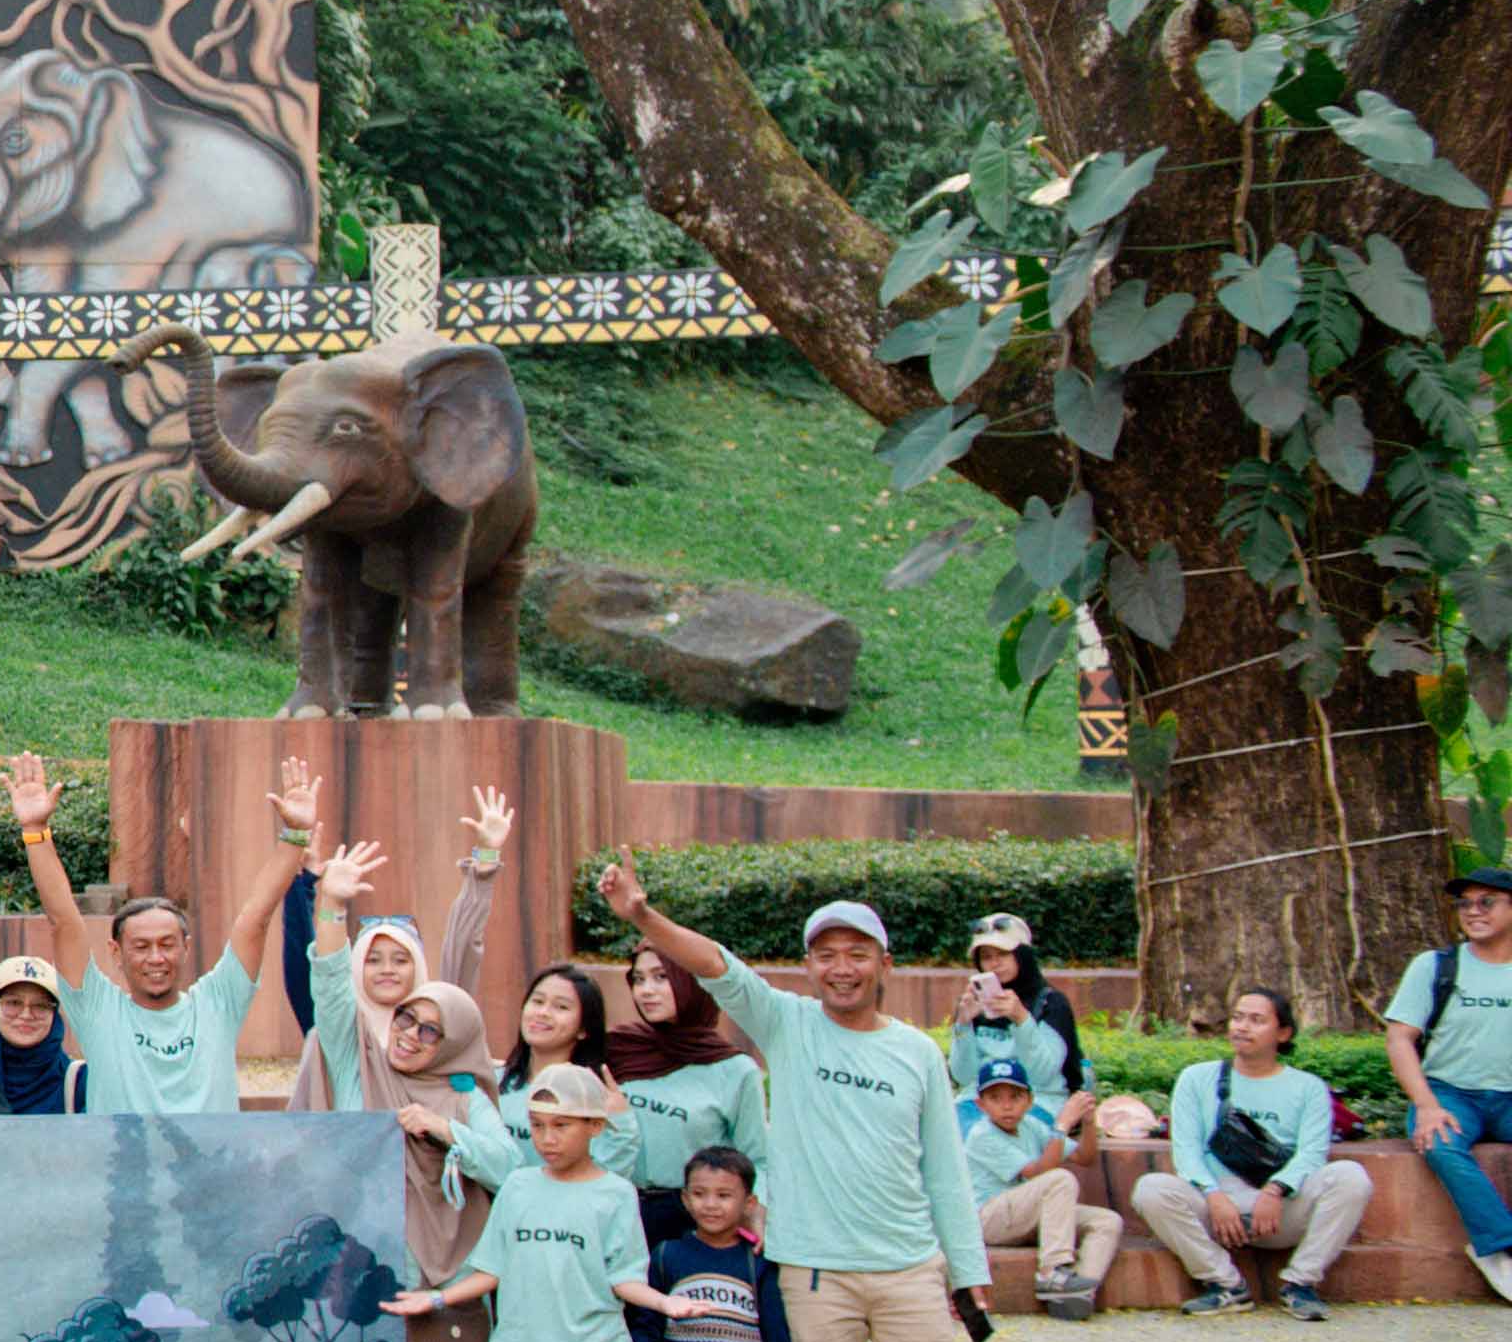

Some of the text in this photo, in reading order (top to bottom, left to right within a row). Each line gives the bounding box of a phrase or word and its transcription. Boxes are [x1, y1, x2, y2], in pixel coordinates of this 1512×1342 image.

[1460, 996, 1512, 1008] DOW
[815, 1066, 896, 1097] DOWA
[622, 1090, 689, 1123] OWA
[516, 1228, 585, 1249] DOWA
